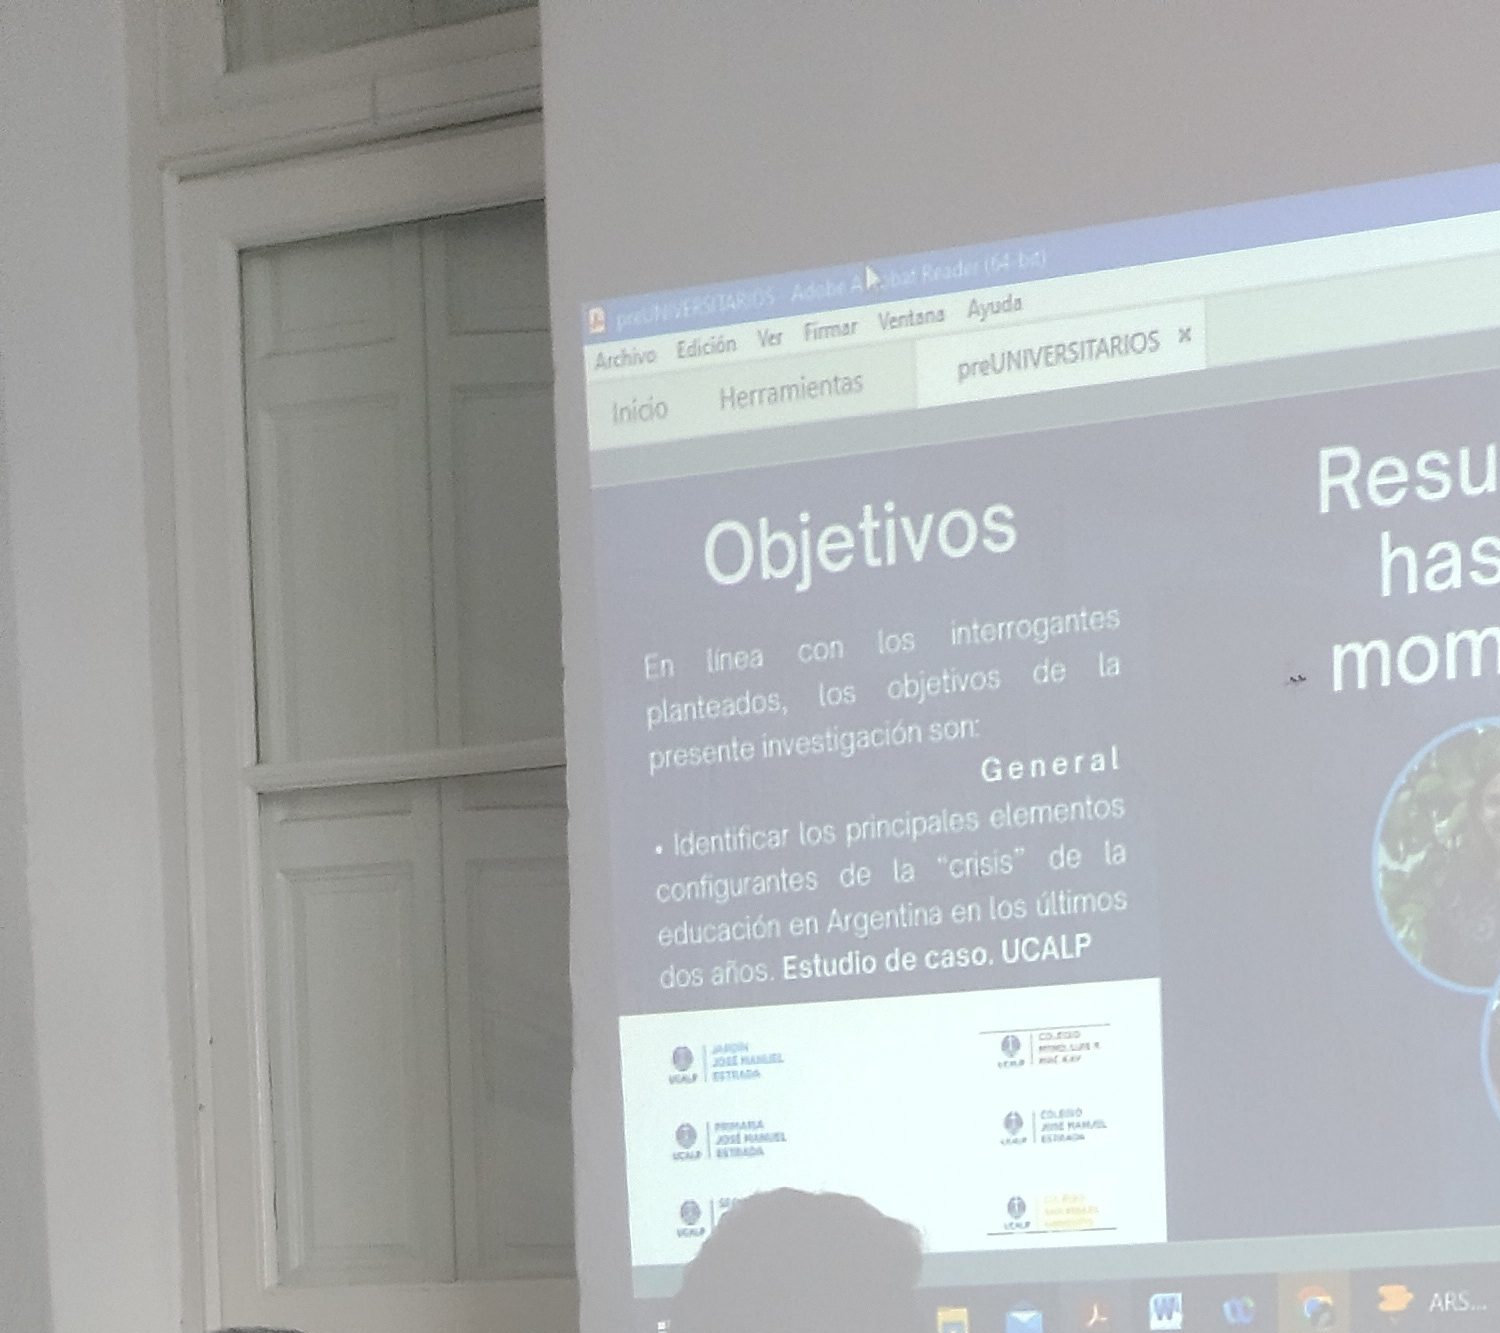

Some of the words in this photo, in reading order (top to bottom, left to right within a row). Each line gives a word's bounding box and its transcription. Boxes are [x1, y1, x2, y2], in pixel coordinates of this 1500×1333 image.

[850, 267, 916, 297] Aobat
[595, 345, 657, 371] Archivo
[677, 334, 737, 360] Edición
[757, 328, 783, 348] Ver
[804, 317, 858, 342] Firmar
[879, 305, 945, 330] Ventana
[967, 294, 1023, 319] Ayuda
[612, 398, 668, 424] Inicio
[719, 372, 863, 411] Herramientas
[957, 331, 1160, 382] preUNIVERSITARIOS
[705, 501, 1017, 593] Objetivos
[644, 653, 674, 680] En
[707, 647, 764, 672] línea
[798, 637, 844, 663] con
[878, 629, 915, 656] los
[950, 607, 1120, 648] interrogantes
[647, 691, 788, 731] planteados,
[819, 682, 856, 707] los
[887, 667, 1001, 703] objetivos
[1033, 659, 1066, 685] de
[1098, 652, 1120, 678] la
[649, 740, 755, 775] presente
[762, 720, 922, 760] investigación
[928, 718, 980, 742] son:
[981, 746, 1120, 782] General
[674, 824, 788, 857] Identificar
[800, 820, 835, 845] los
[846, 809, 979, 844] principales
[990, 795, 1125, 828] elementos
[656, 867, 817, 904] configurantes
[840, 862, 871, 887] de
[893, 858, 915, 882] la
[1049, 845, 1081, 868] de
[1104, 840, 1126, 864] la
[658, 910, 780, 946] educación
[789, 914, 818, 936] en
[827, 896, 942, 938] Argentina
[951, 901, 981, 922] en
[989, 895, 1026, 920] los
[1036, 888, 1127, 916] últimos
[659, 962, 704, 989] dos
[711, 956, 775, 984] años.
[782, 948, 876, 979] Estudio
[885, 945, 916, 972] de
[1001, 932, 1091, 963] UCALP
